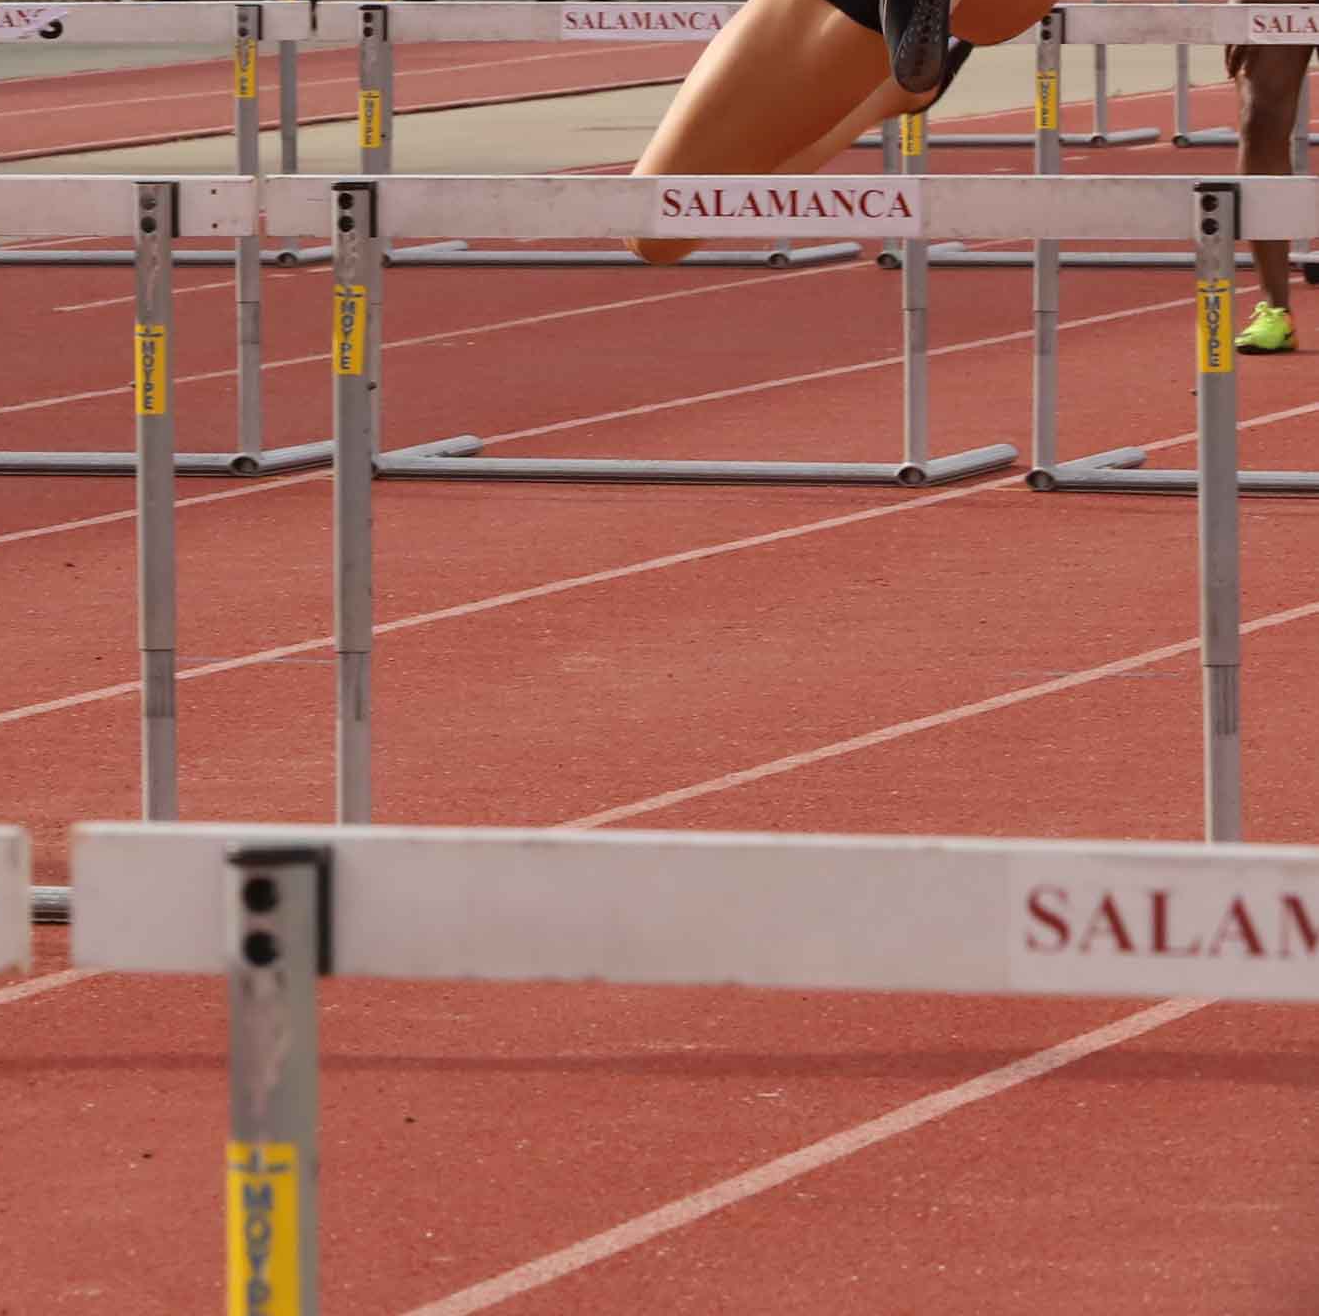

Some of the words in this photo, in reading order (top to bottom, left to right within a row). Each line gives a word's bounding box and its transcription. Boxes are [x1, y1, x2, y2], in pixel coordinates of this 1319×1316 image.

[564, 11, 722, 30] SALAMANCA
[662, 188, 913, 218] SALAMANCA
[339, 300, 356, 370] MOYPE
[1204, 295, 1220, 367] MOYPE
[141, 340, 156, 410] MOYPE
[242, 1183, 273, 1316] MOYP
